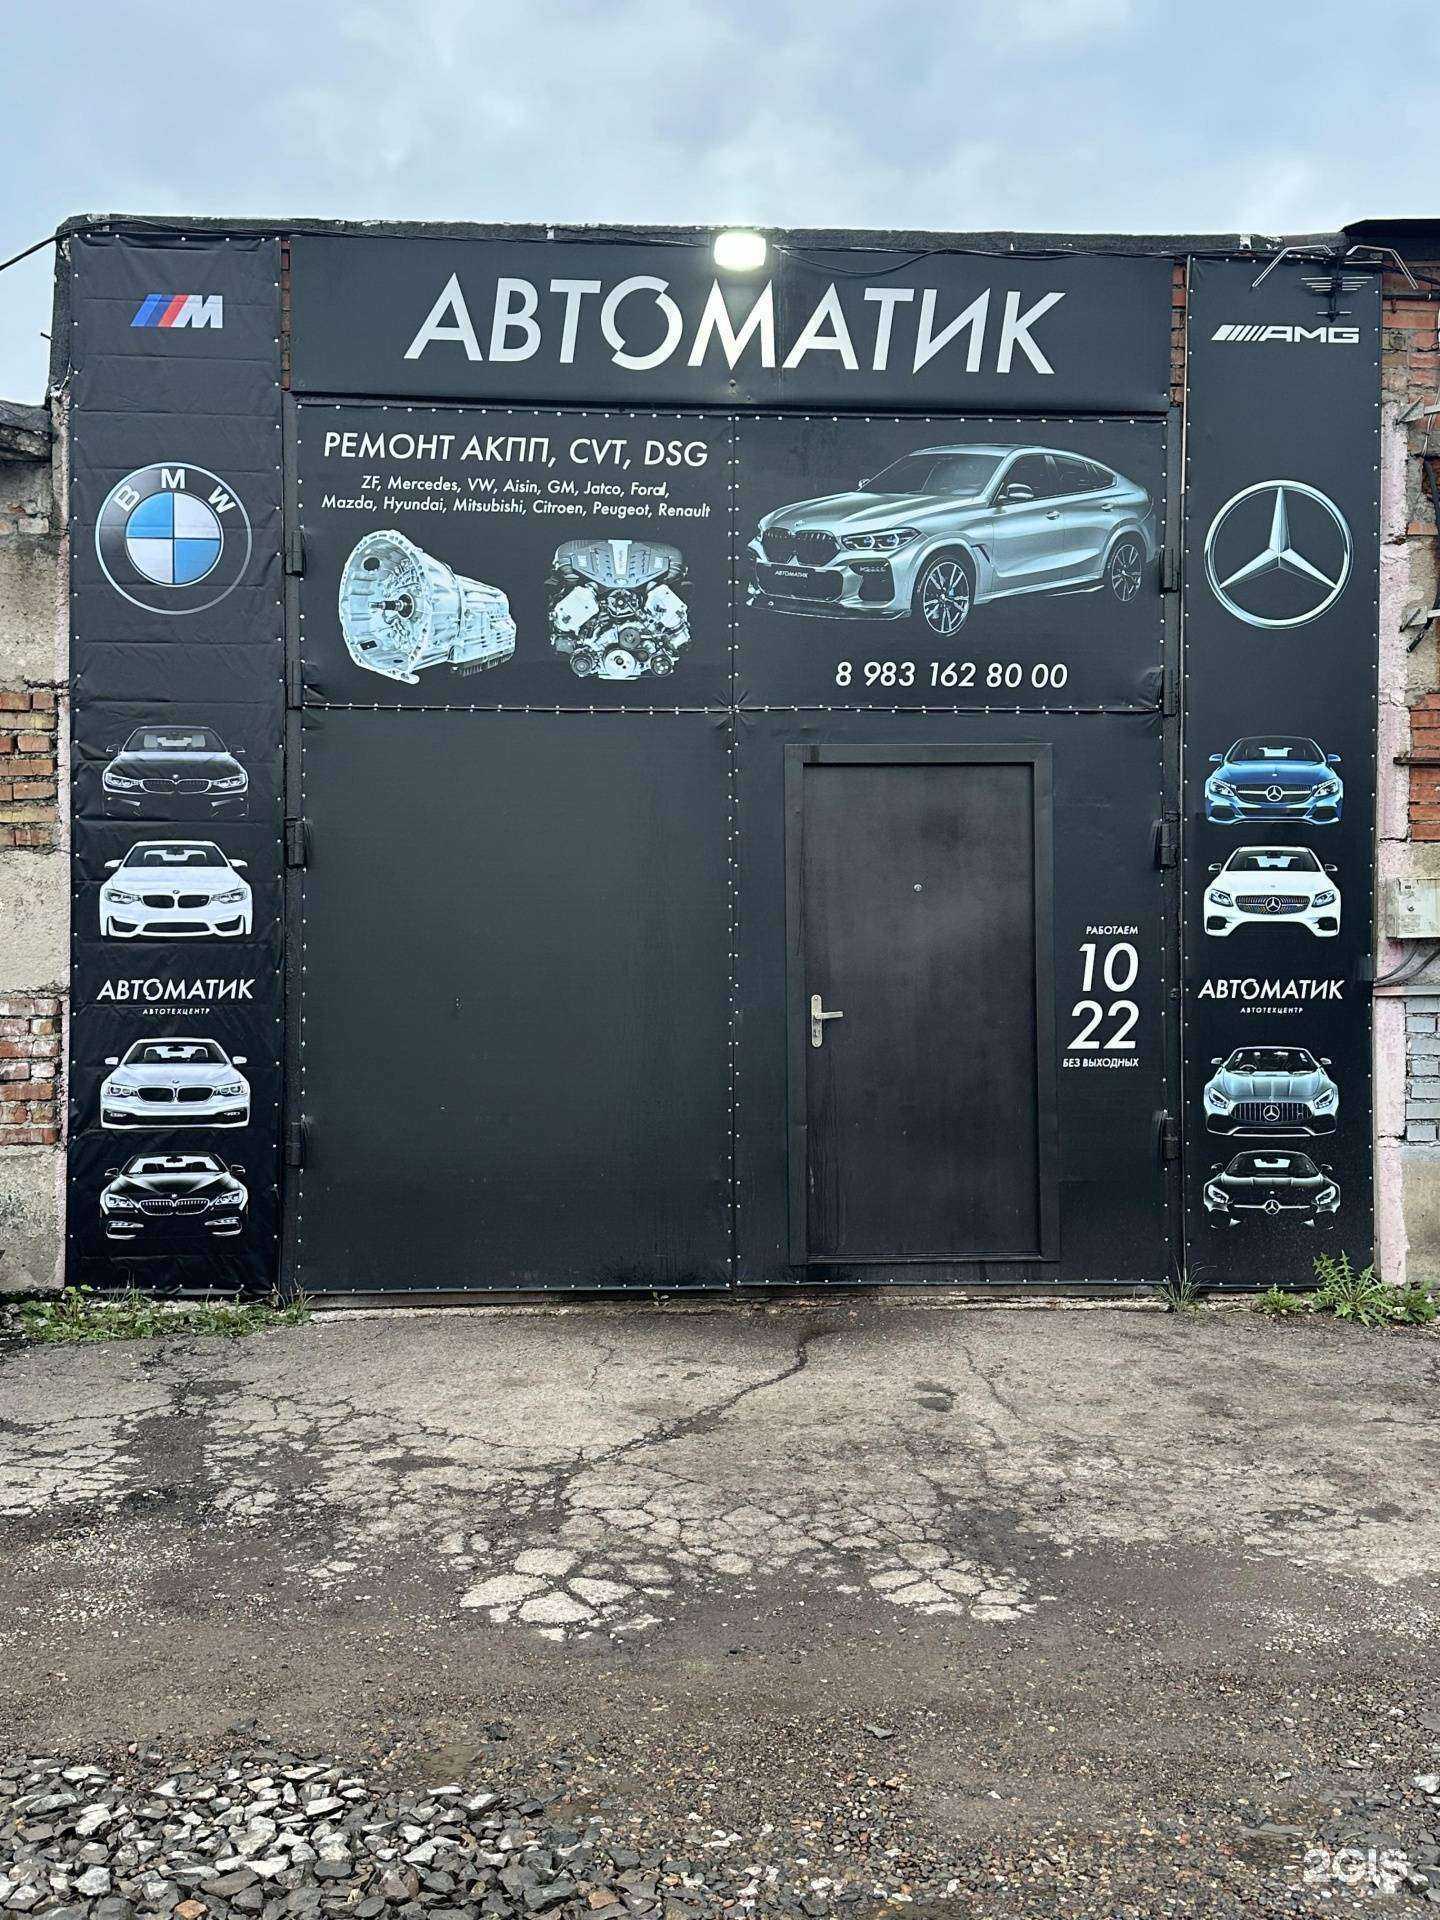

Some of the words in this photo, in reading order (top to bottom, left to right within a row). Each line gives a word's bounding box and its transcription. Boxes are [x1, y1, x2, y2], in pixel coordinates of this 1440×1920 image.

[403, 272, 1066, 376] АВТОМАТИК
[1259, 325, 1360, 344] AMG
[323, 432, 455, 460] РЕМОНТ
[460, 436, 557, 468] АКПП,
[569, 438, 632, 470] CVT,
[644, 441, 708, 467] DSG
[113, 468, 236, 513] BMW
[361, 475, 382, 491] ZF,
[387, 476, 462, 493] Mercedes,
[467, 477, 498, 494] VW,
[503, 479, 542, 495] Aisin,
[547, 480, 579, 497] GM,
[583, 481, 625, 497] Jatco,
[321, 494, 378, 512] Mazda,
[383, 496, 447, 513] Hyundai,
[453, 498, 527, 515] Mitsubishi,
[532, 500, 587, 516] Citroen,
[593, 501, 653, 519] Peugeot,
[658, 503, 711, 518] Renault
[836, 661, 852, 687] 8
[864, 661, 915, 687] 983
[929, 662, 976, 687] 162
[986, 663, 1023, 688] 80
[1031, 663, 1068, 688] 00
[1085, 926, 1139, 935] РАБОТАЕМ
[1078, 943, 1139, 992] 10
[96, 978, 256, 1001] АВТОМАТИК
[1197, 978, 1345, 1001] АВТОМАТИК
[142, 1007, 210, 1016] АВТОТЕХЦЕНТР
[1240, 1006, 1304, 1015] АВТОТЕХЦЕНТР
[1067, 1000, 1138, 1050] 22
[1062, 1058, 1081, 1068] БЕЗ
[1083, 1057, 1139, 1068] ВЫХОДНЫХ
